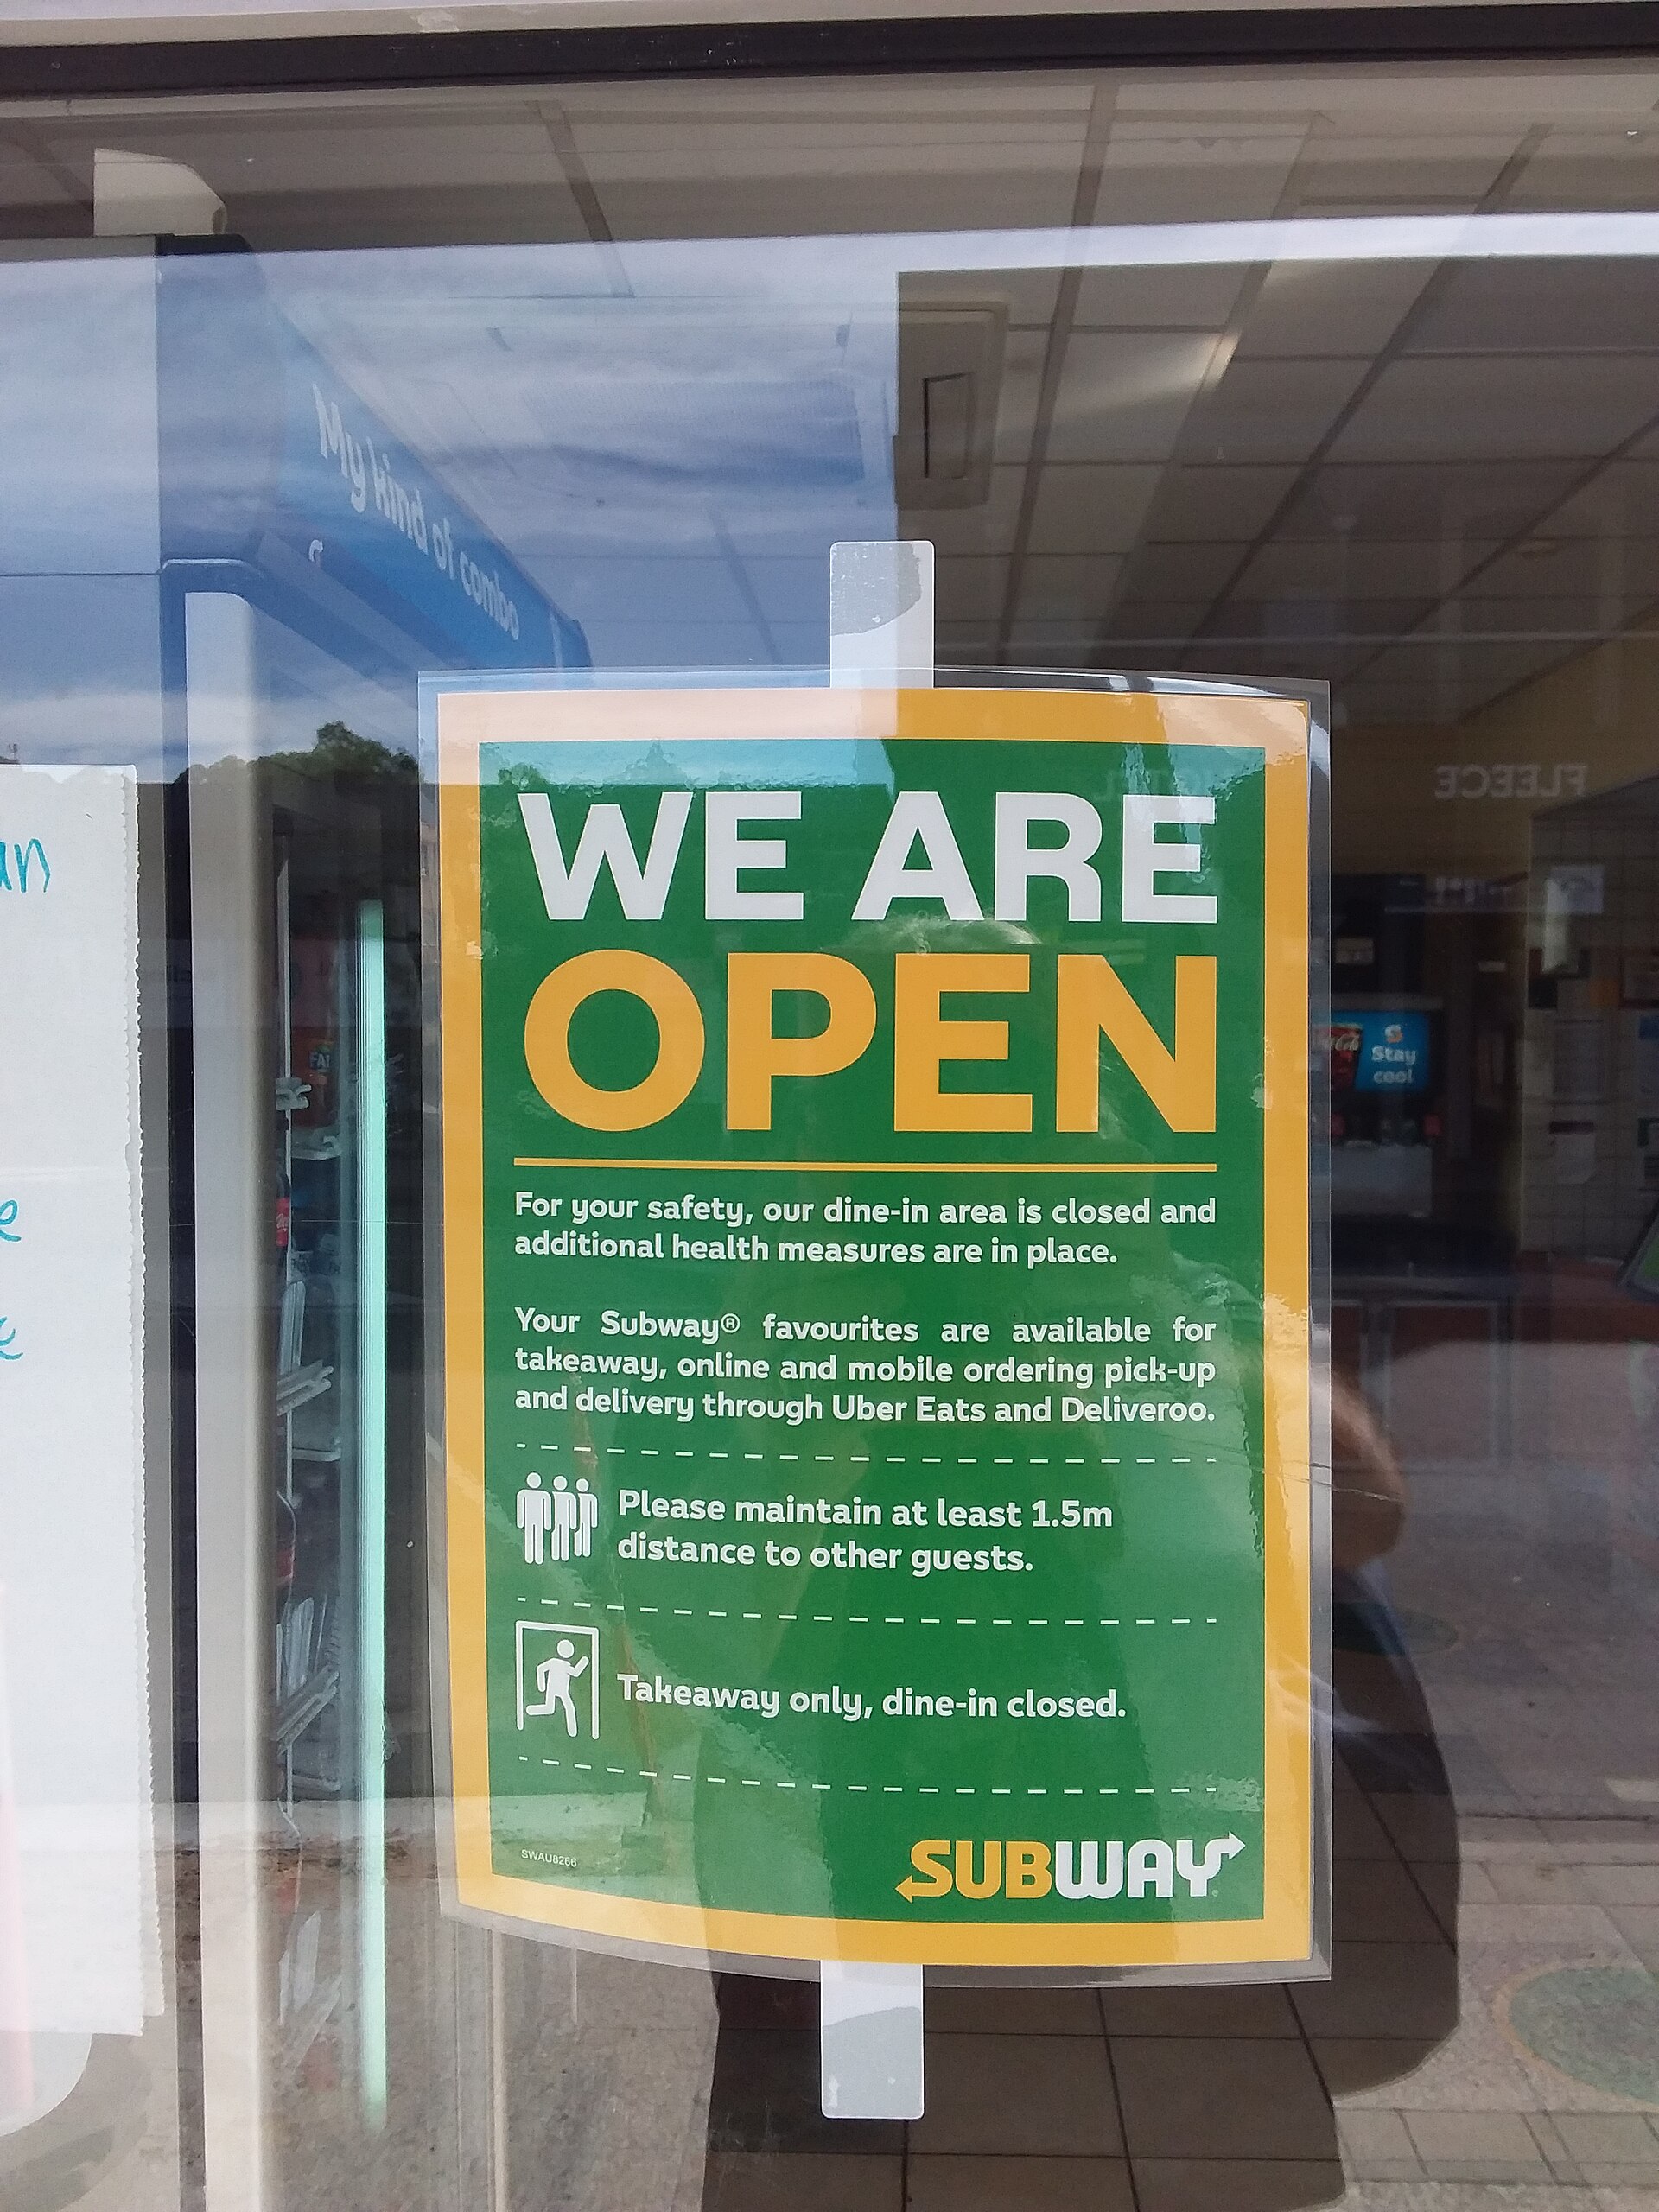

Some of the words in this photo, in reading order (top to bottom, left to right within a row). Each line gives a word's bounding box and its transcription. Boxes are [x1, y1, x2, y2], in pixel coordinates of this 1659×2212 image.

[312, 383, 366, 513] My
[366, 436, 429, 555] kind
[432, 518, 455, 580] of
[459, 551, 518, 641] combo
[518, 791, 804, 921] WE
[851, 791, 1217, 923] ARE
[524, 949, 1217, 1133] OPEN
[1372, 1045, 1416, 1067] Stay
[1373, 1069, 1413, 1084] cool
[516, 1192, 563, 1217] For
[572, 1199, 639, 1224] your
[647, 1194, 753, 1228] safety,
[763, 1203, 815, 1222] our
[823, 1196, 929, 1223] dine-in
[939, 1205, 1007, 1224] area
[1018, 1198, 1042, 1224] is
[1052, 1198, 1150, 1224] closed
[1160, 1198, 1216, 1224] and
[515, 1230, 664, 1258] additional
[672, 1233, 769, 1261] health
[778, 1243, 925, 1262] measures
[933, 1244, 982, 1263] are
[991, 1236, 1018, 1263] in
[1027, 1237, 1117, 1269] place.
[514, 1306, 581, 1333] Your
[762, 1313, 918, 1342] favourites
[941, 1324, 990, 1343] are
[1012, 1316, 1151, 1343] available
[1173, 1315, 1217, 1342] for
[515, 1345, 667, 1382] takeaway,
[677, 1351, 770, 1379] online
[780, 1354, 836, 1380] and
[849, 1355, 953, 1382] mobile
[963, 1356, 1093, 1389] ordering
[1105, 1356, 1216, 1389] pick-up
[515, 1385, 568, 1410] and
[575, 1386, 694, 1422] delivery
[702, 1391, 823, 1426] through
[832, 1394, 908, 1421] Uber
[916, 1396, 986, 1421] Eats
[995, 1395, 1052, 1422] and
[1061, 1395, 1215, 1422] Deliveroo.
[619, 1489, 726, 1521] Please
[735, 1494, 881, 1525] maintain
[892, 1501, 928, 1526] at
[938, 1498, 1022, 1527] least
[1032, 1500, 1112, 1528] 1.5m
[618, 1531, 756, 1565] distance
[764, 1541, 801, 1567] to
[810, 1540, 903, 1569] other
[911, 1545, 1033, 1577] guests.
[616, 1673, 779, 1719] Takeaway
[789, 1685, 873, 1722] only,
[882, 1687, 997, 1717] dine-in
[1007, 1688, 1126, 1718] closed.
[521, 1848, 577, 1867] SWAU8266
[895, 1831, 1246, 1903] SUBWAY
